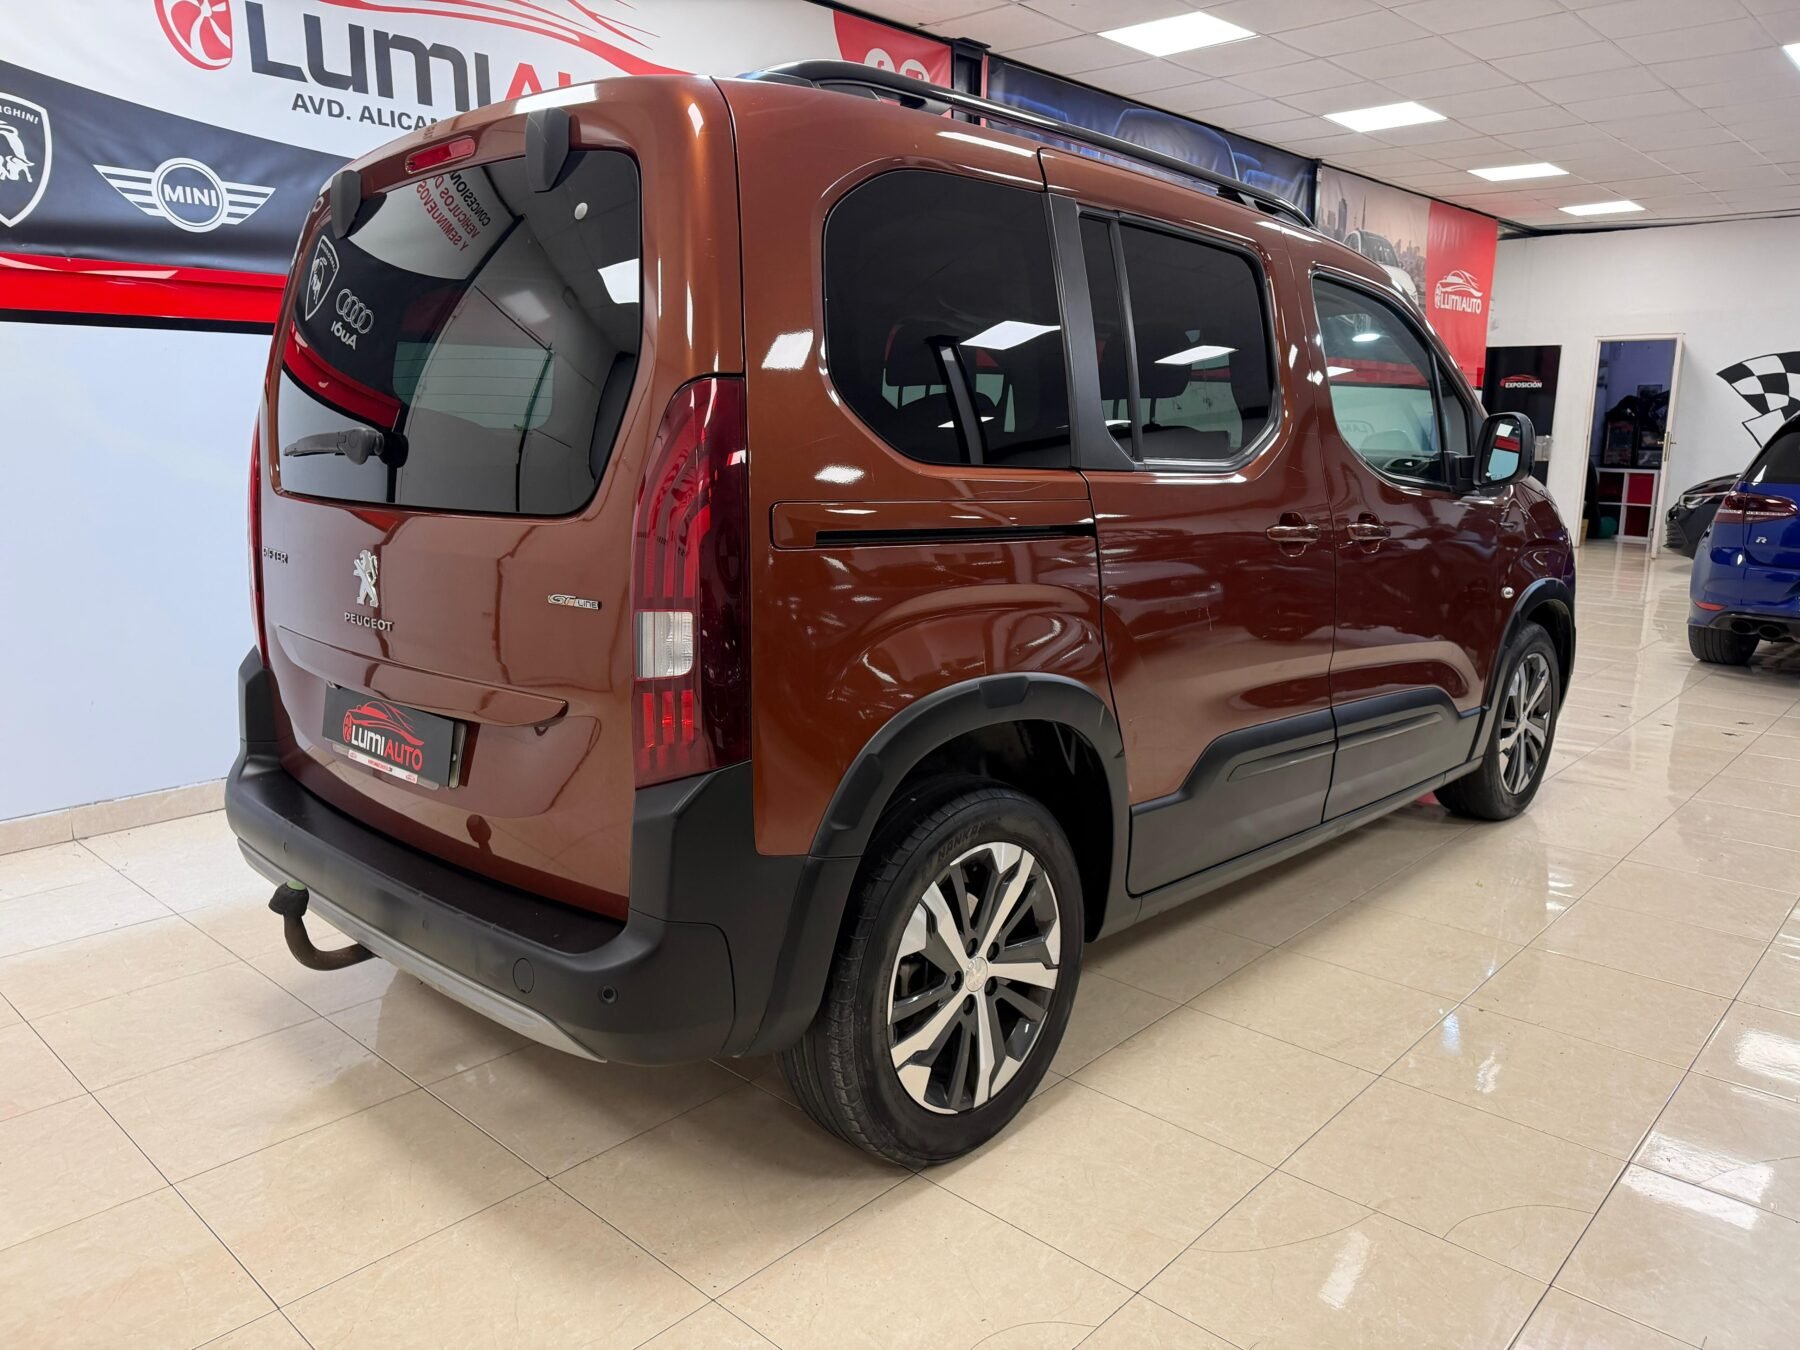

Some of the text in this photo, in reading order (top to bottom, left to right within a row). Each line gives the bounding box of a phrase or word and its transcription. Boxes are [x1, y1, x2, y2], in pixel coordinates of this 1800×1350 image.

[245, 0, 571, 112] LUMIA
[291, 93, 437, 131] AVD. ALICA
[163, 183, 218, 207] MINI
[1440, 293, 1482, 315] LUMIAUTO
[344, 611, 393, 632] PEUGEOT
[351, 725, 423, 771] LUMIAUTO
